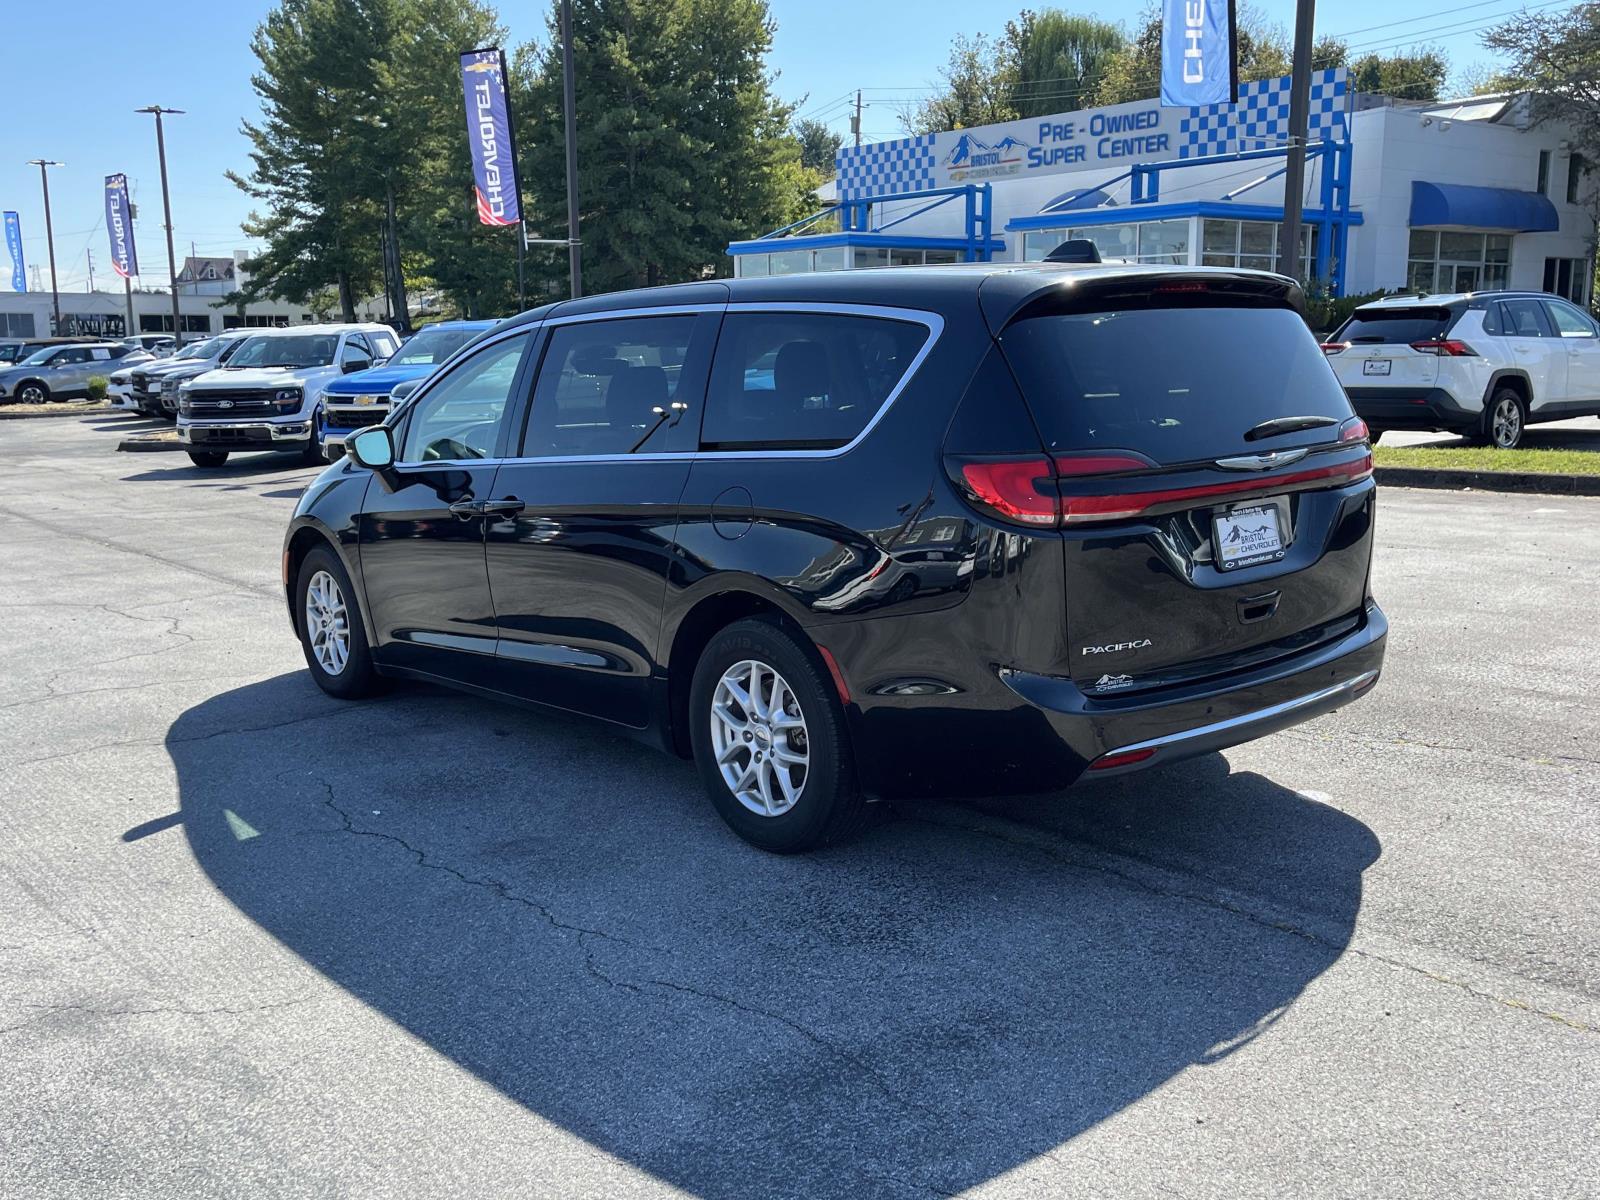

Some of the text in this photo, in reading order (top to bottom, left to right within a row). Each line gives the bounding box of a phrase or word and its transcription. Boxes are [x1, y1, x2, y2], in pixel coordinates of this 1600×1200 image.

[1027, 133, 1169, 168] SUPER CENTER
[970, 152, 1000, 168] BRISTOL
[1241, 533, 1266, 544] BRISTOL
[1241, 539, 1279, 553] CHEVROLET
[1082, 639, 1152, 656] PACIFICA
